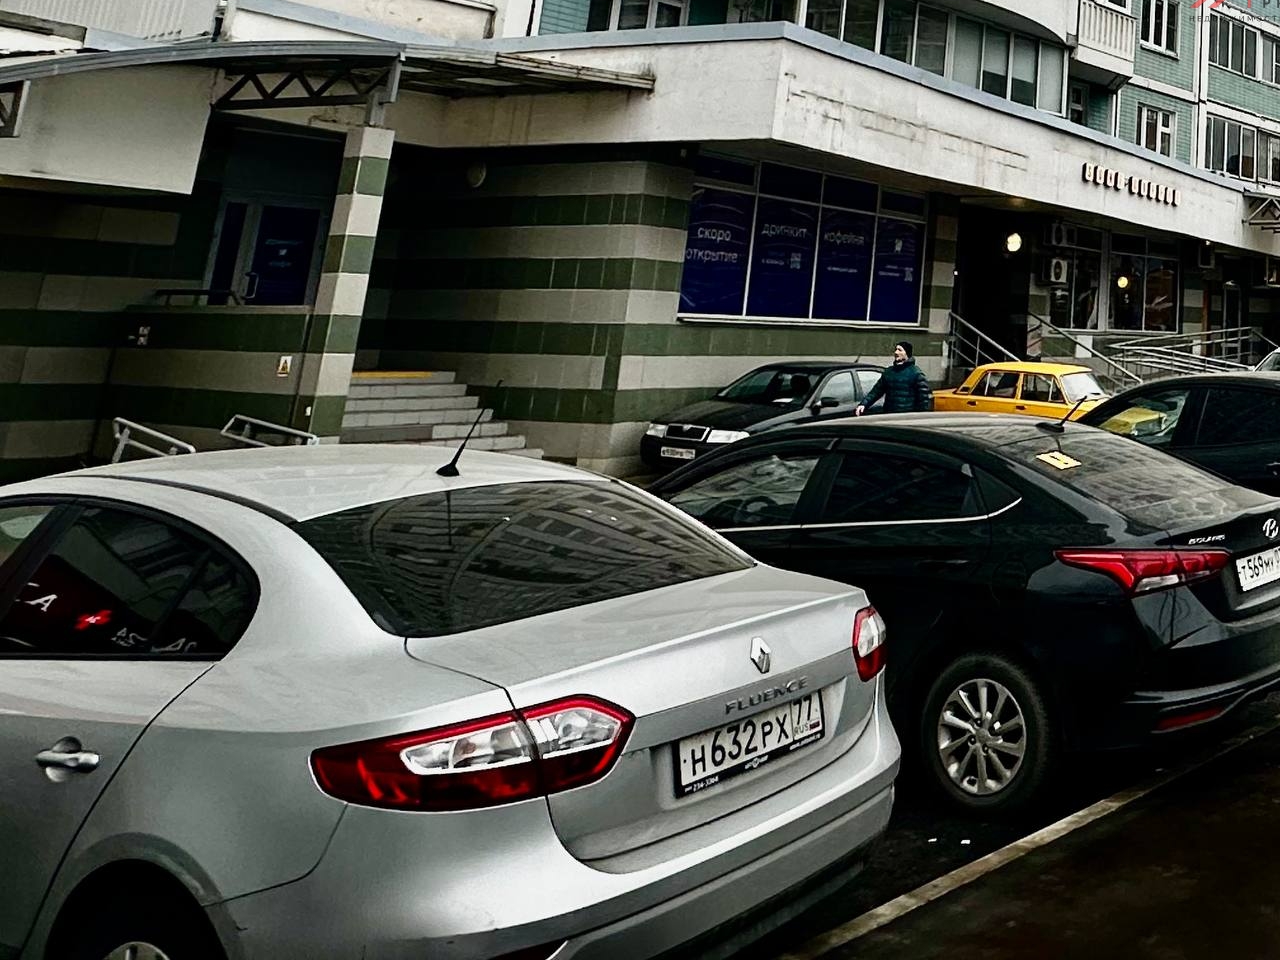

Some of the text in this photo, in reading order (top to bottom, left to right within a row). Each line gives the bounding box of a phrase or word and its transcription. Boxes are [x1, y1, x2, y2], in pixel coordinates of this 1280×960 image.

[696, 226, 733, 244] скоро
[823, 230, 866, 246] кофейня
[685, 247, 739, 264] открытие
[724, 676, 808, 715] FLUENCE
[792, 695, 813, 726] 77
[793, 721, 810, 737] RUS
